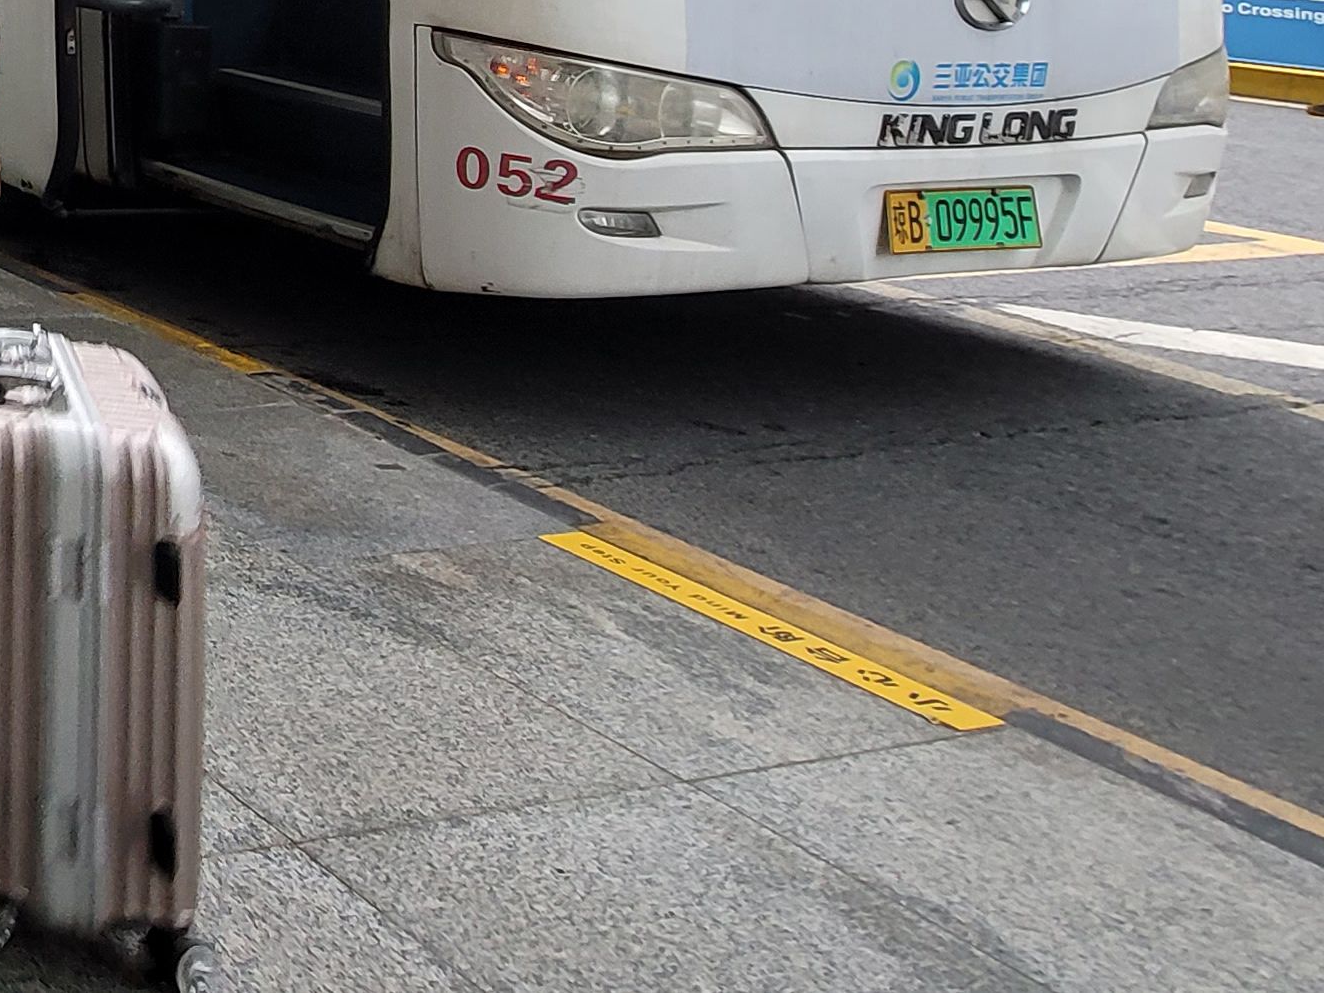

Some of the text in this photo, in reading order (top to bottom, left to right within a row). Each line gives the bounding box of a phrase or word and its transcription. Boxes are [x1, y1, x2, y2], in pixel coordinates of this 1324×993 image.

[1221, 3, 1234, 14] o
[932, 62, 1049, 89] 三亚公交集团
[878, 108, 1078, 147] KING LONG
[456, 146, 579, 206] 052
[579, 542, 627, 565] Step
[630, 565, 682, 592] Your
[688, 593, 750, 621] Mind
